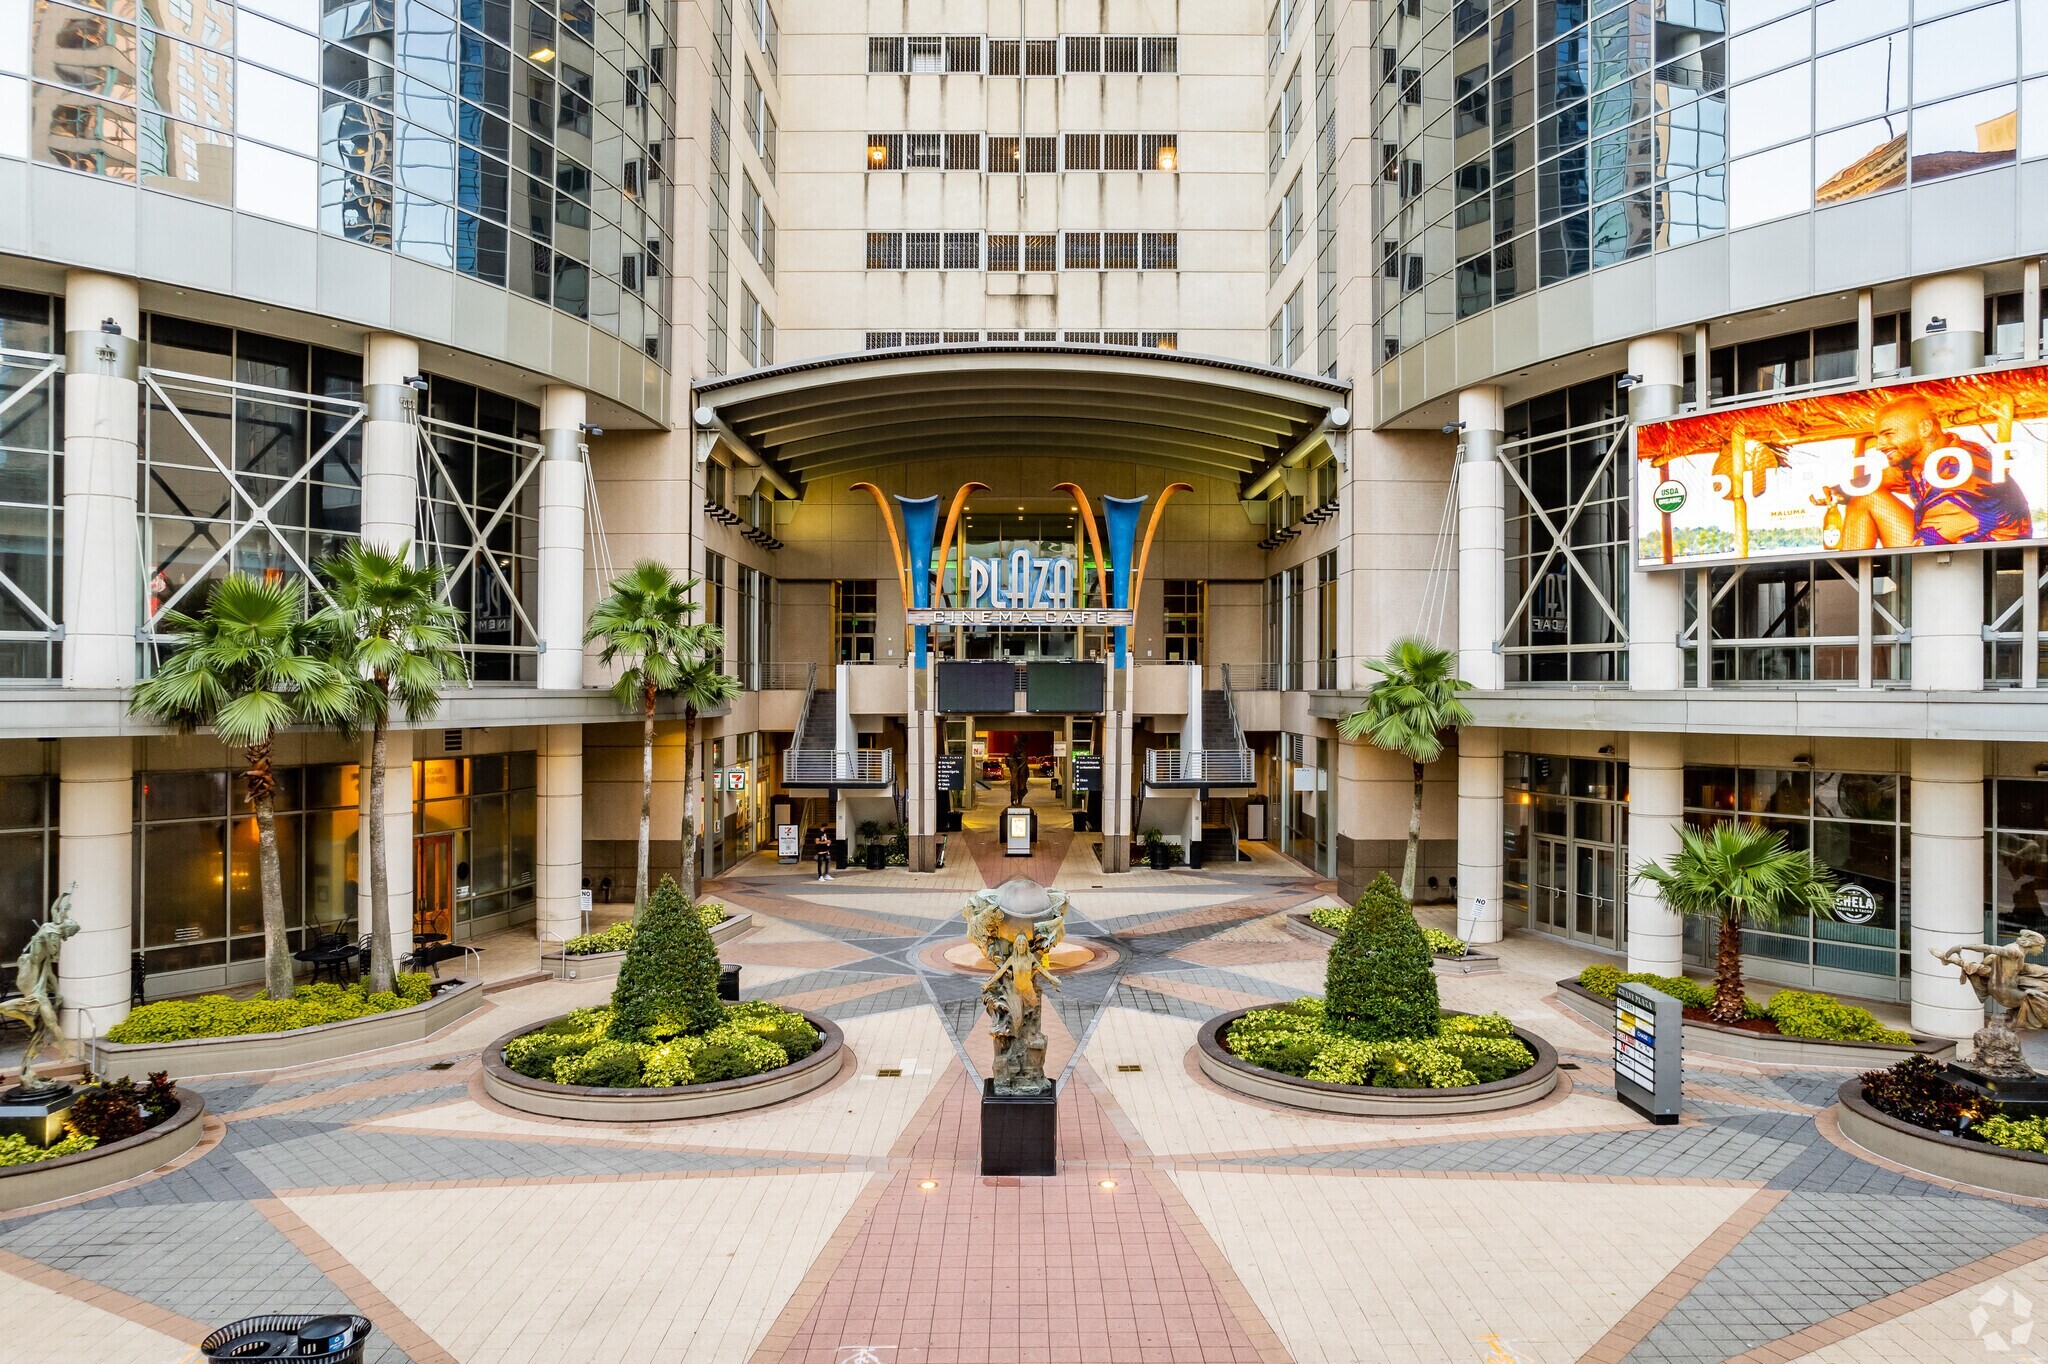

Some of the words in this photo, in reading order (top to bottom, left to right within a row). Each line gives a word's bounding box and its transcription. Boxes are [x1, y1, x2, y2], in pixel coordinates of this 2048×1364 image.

[1661, 488, 1679, 496] USDA
[1771, 509, 1805, 517] MALUMA
[970, 549, 1072, 609] PLAZA
[933, 611, 1032, 623] CINEMA
[1045, 611, 1108, 624] CAFE
